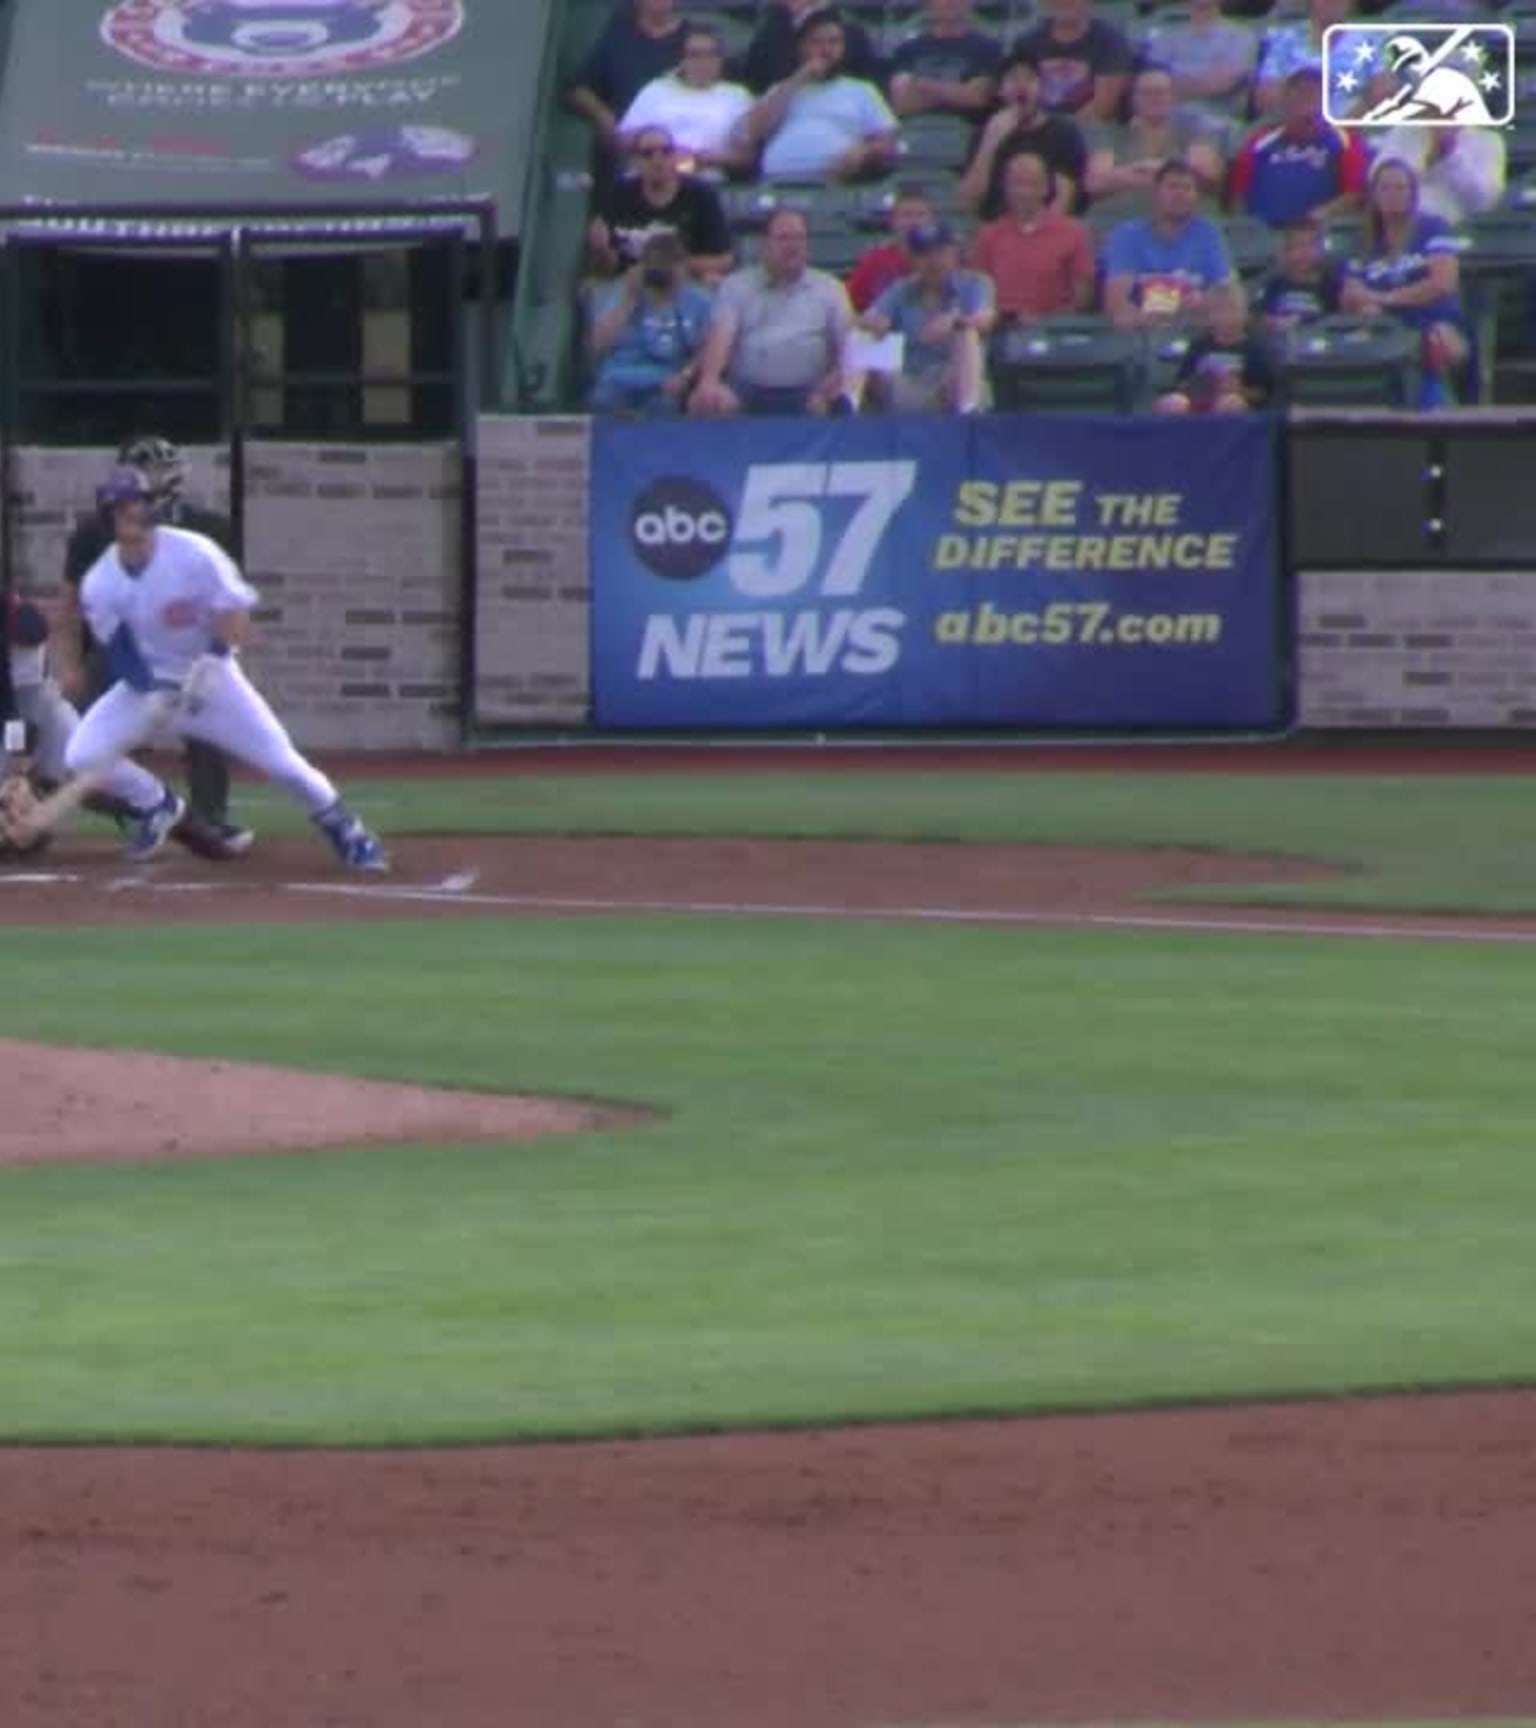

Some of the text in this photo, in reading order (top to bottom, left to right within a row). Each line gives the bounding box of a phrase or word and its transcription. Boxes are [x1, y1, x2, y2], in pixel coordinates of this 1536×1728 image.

[953, 478, 1183, 527] SEE THE
[633, 459, 918, 598] abc 57
[933, 532, 1238, 570] DIFFERENCE
[635, 606, 907, 681] NEWS
[934, 602, 1222, 645] abc57.com
